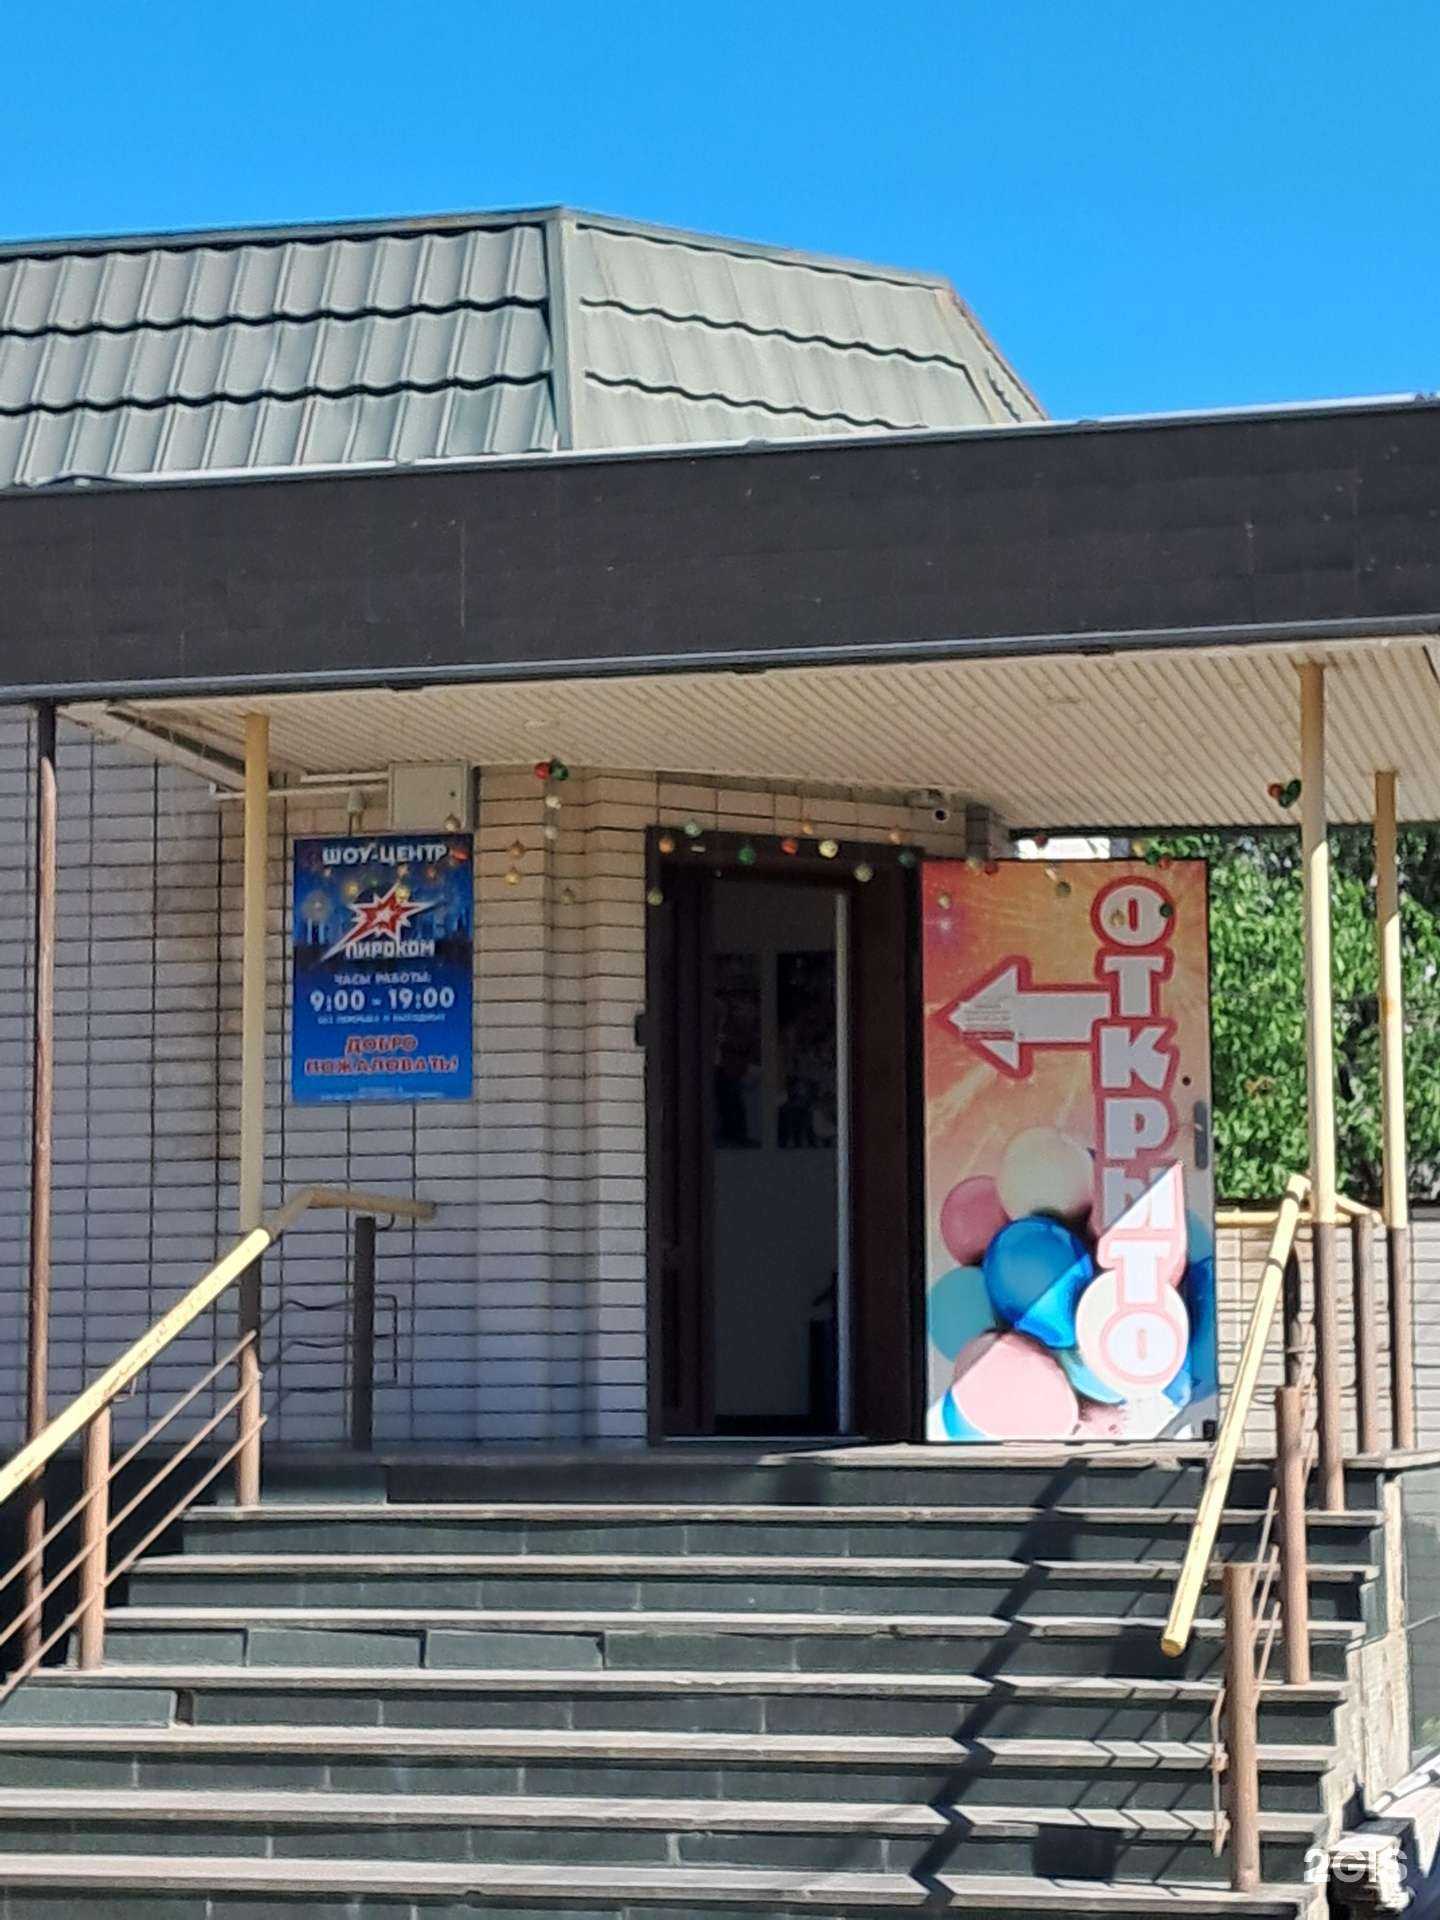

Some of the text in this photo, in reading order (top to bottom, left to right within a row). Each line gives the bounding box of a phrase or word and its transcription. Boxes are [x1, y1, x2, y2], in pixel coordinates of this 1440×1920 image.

[322, 843, 448, 866] ШОУ-ЦЕНТР
[345, 939, 436, 960] ПИРОКОМ
[333, 973, 371, 985] ЧАСЫ
[309, 988, 366, 1012] 9:00
[388, 986, 456, 1010] 19:00
[345, 1034, 418, 1056] ДОБРО
[1096, 881, 1178, 1380] ОТКРЫТО
